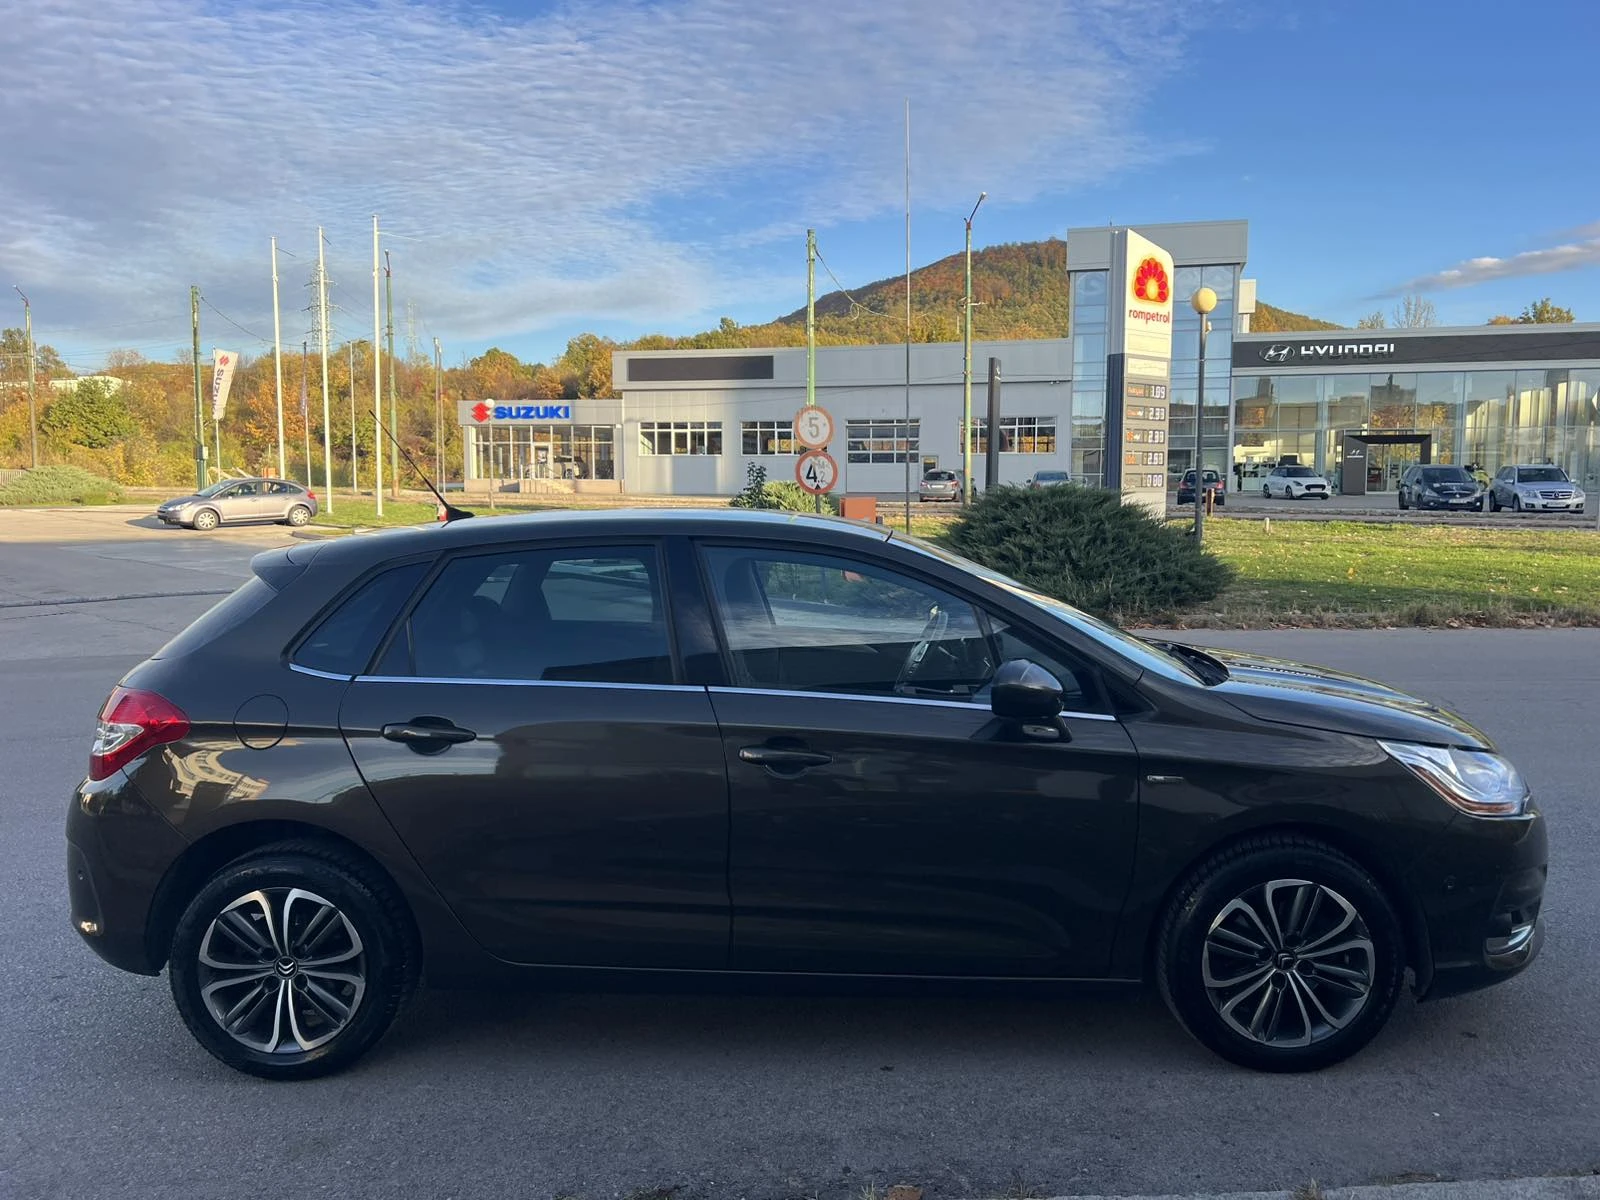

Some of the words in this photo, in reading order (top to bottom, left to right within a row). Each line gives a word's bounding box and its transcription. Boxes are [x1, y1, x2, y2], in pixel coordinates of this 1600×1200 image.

[1128, 309, 1170, 324] rompetrol
[1300, 343, 1395, 358] HYUNDAI
[494, 406, 570, 419] SUZUKI
[808, 417, 820, 438] 5
